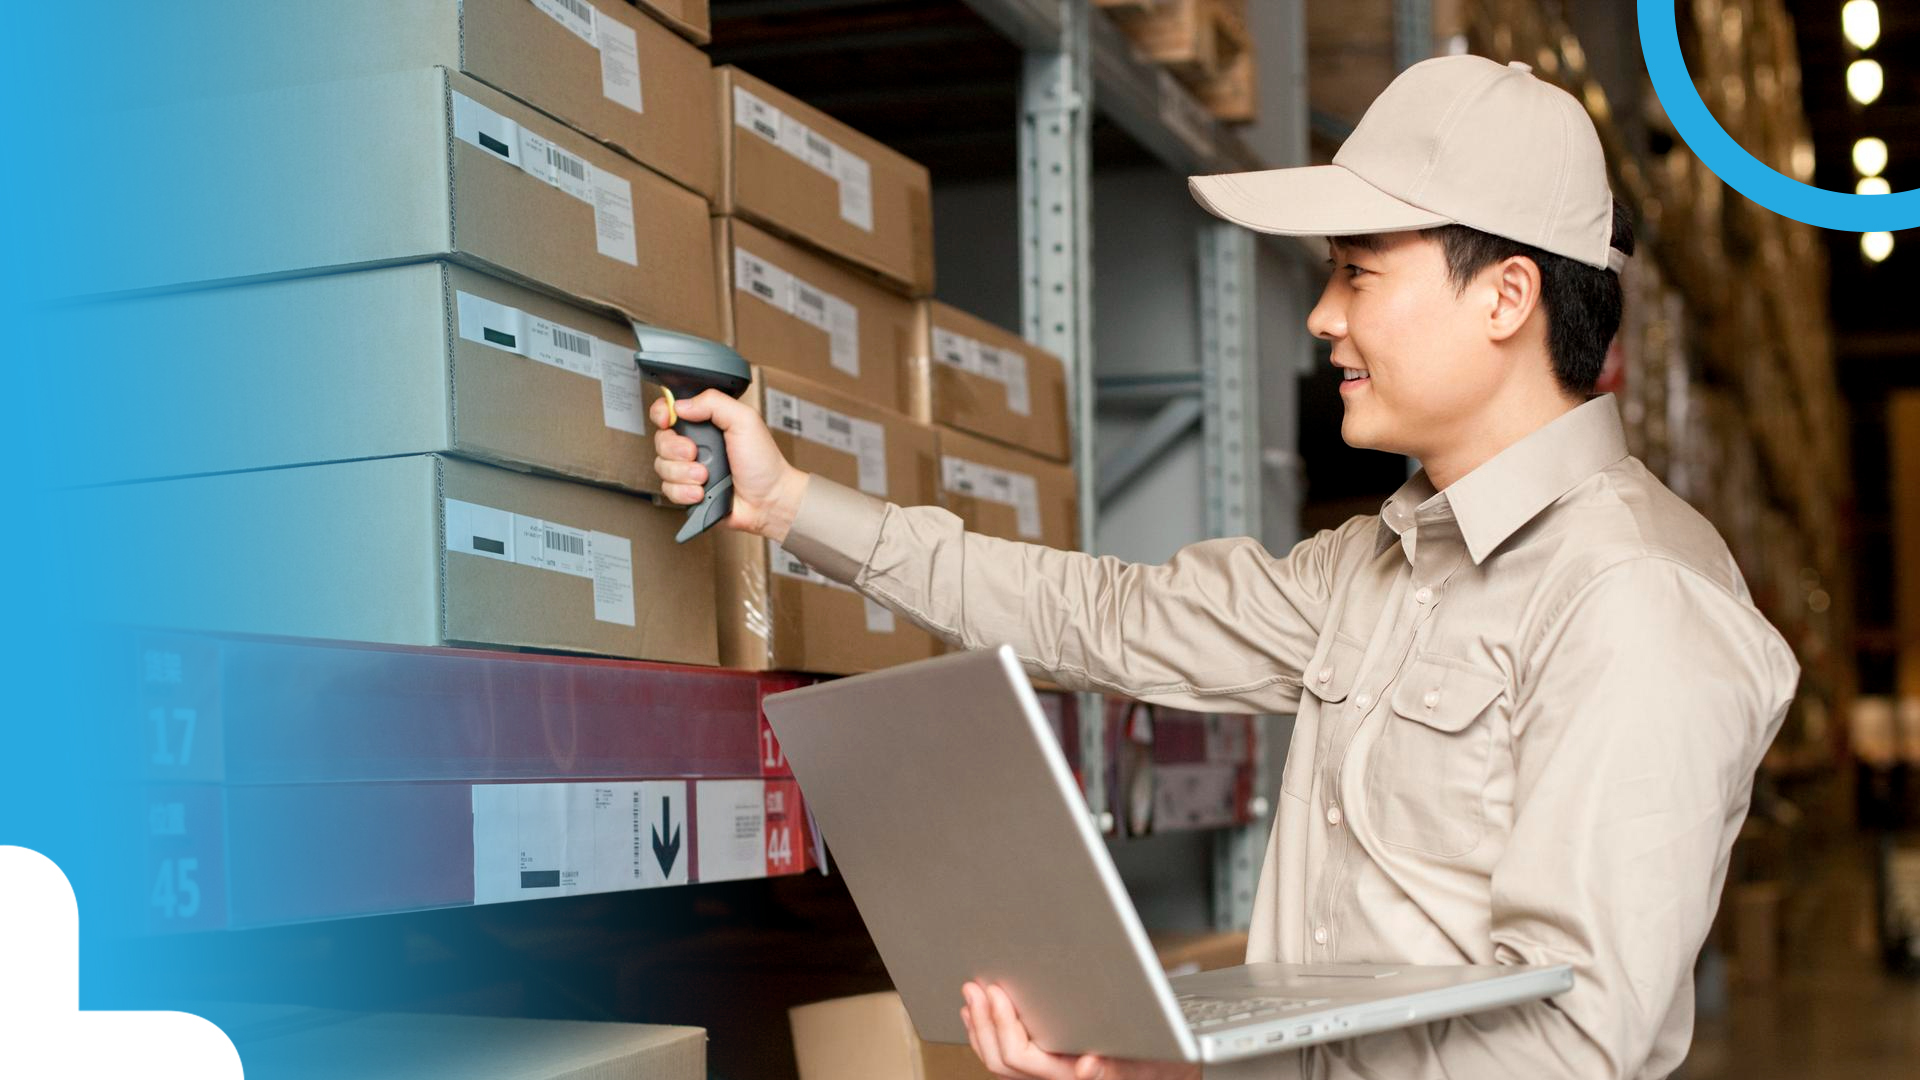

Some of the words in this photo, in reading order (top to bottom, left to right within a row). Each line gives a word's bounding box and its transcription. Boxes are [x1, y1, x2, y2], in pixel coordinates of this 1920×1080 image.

[148, 706, 197, 766] 17
[767, 827, 792, 866] 44
[151, 857, 201, 920] 45
